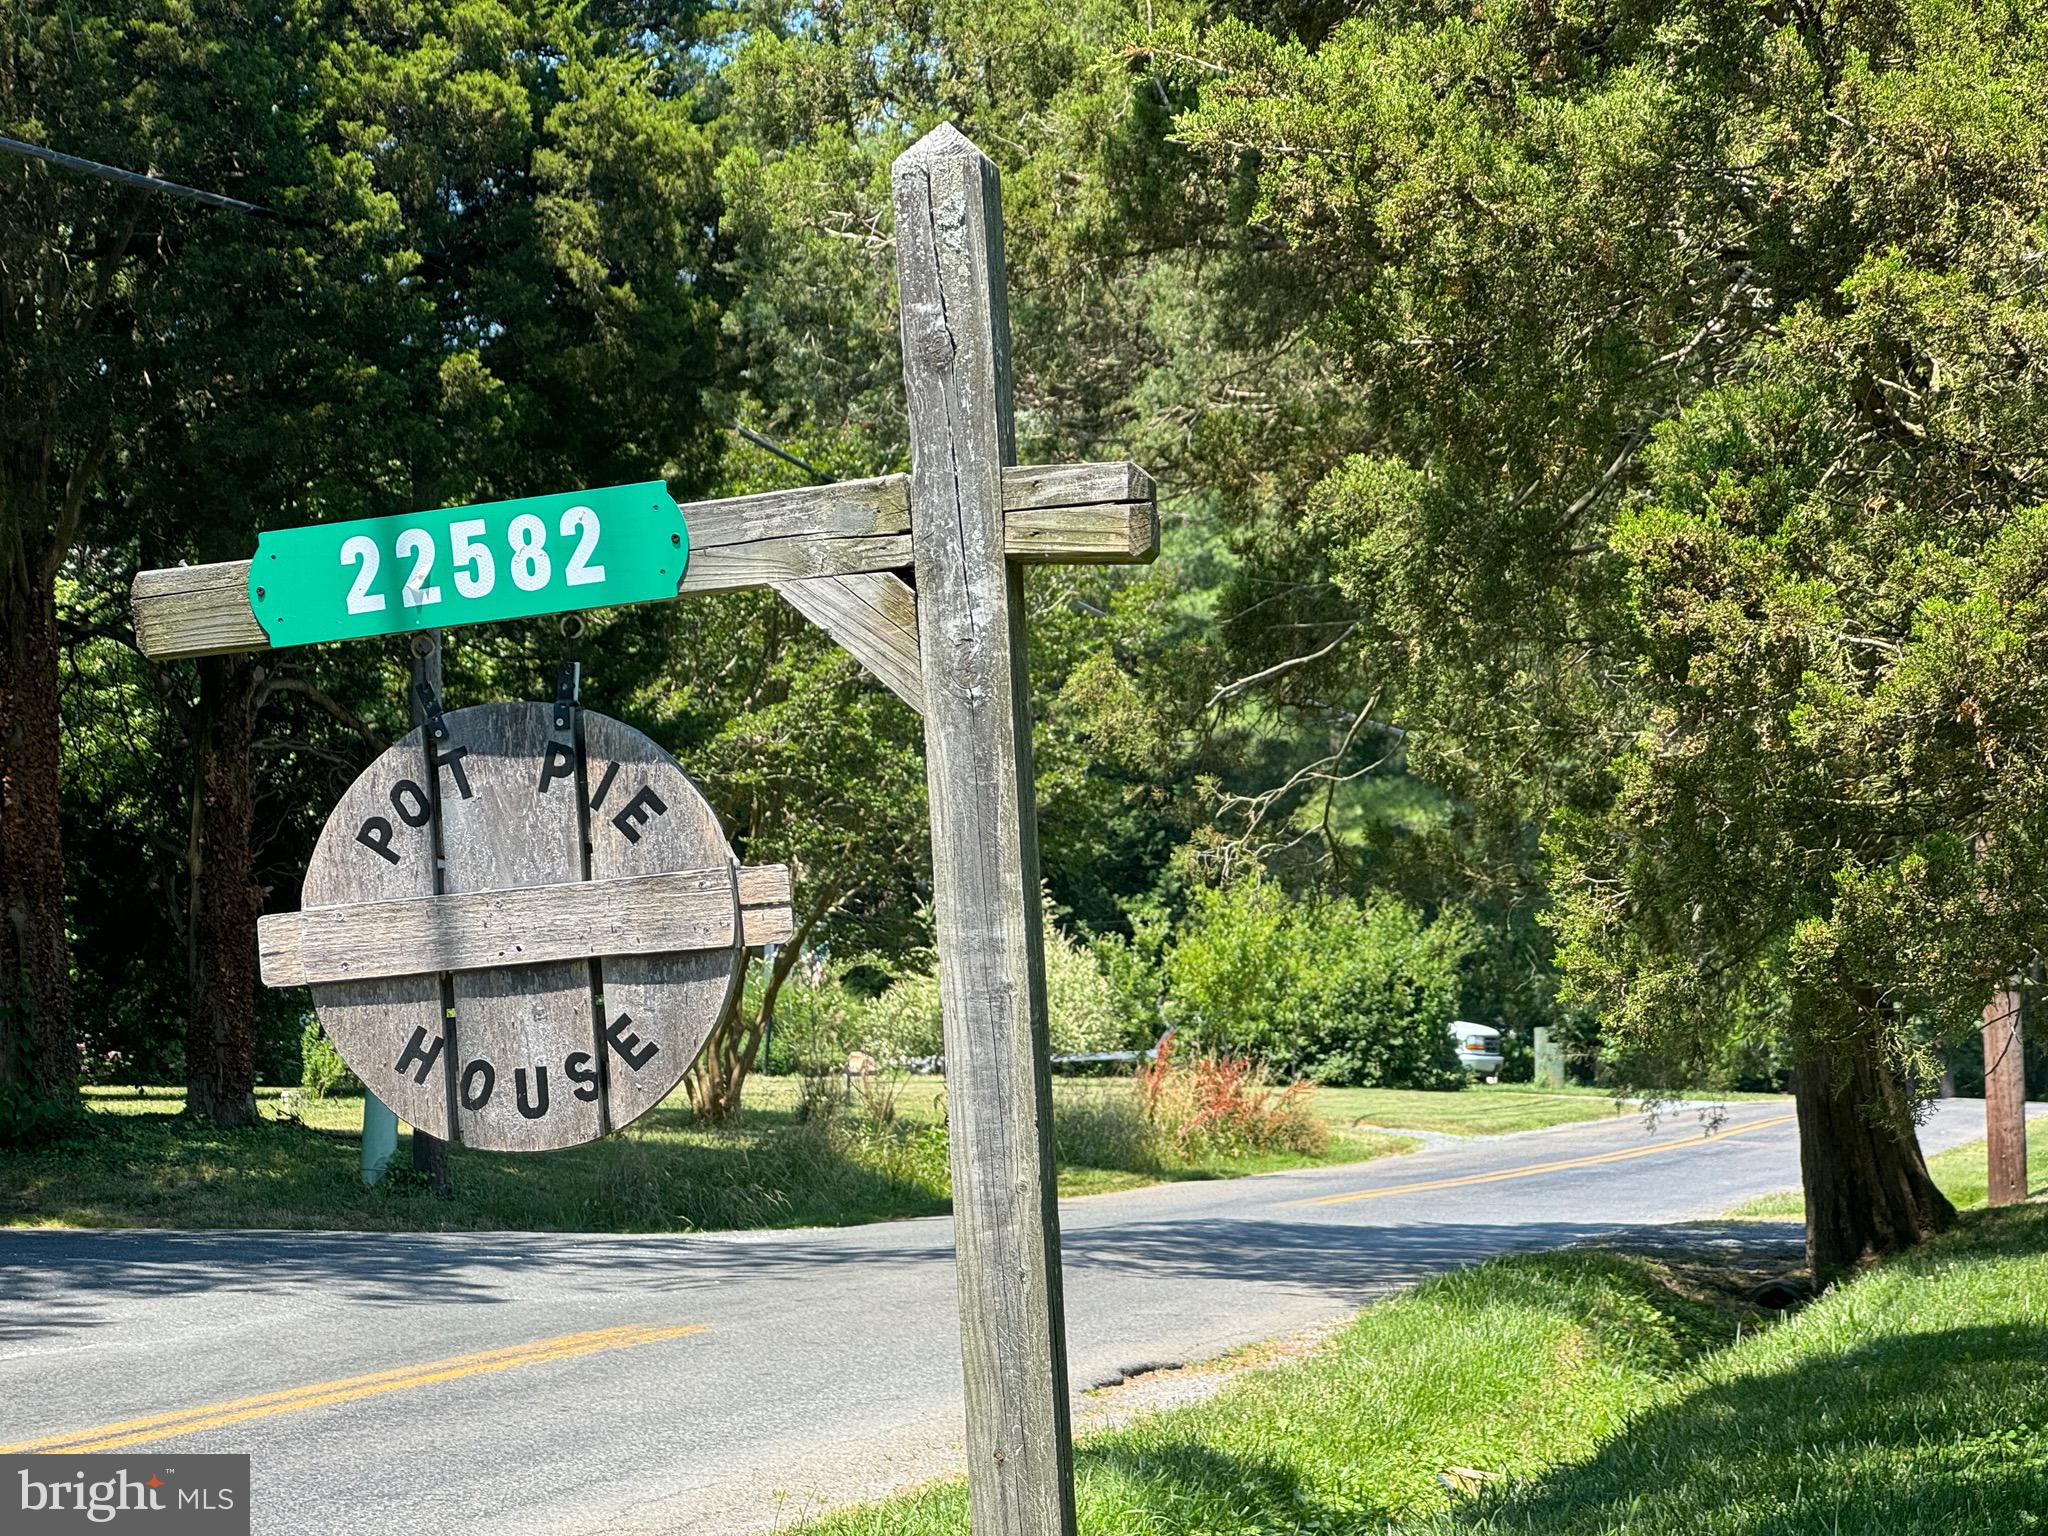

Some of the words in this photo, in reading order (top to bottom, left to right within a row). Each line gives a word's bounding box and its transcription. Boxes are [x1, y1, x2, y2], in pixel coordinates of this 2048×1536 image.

[339, 505, 606, 615] 22582
[355, 745, 474, 864] POT
[538, 740, 668, 844] PIE
[394, 1012, 660, 1119] HOUSE
